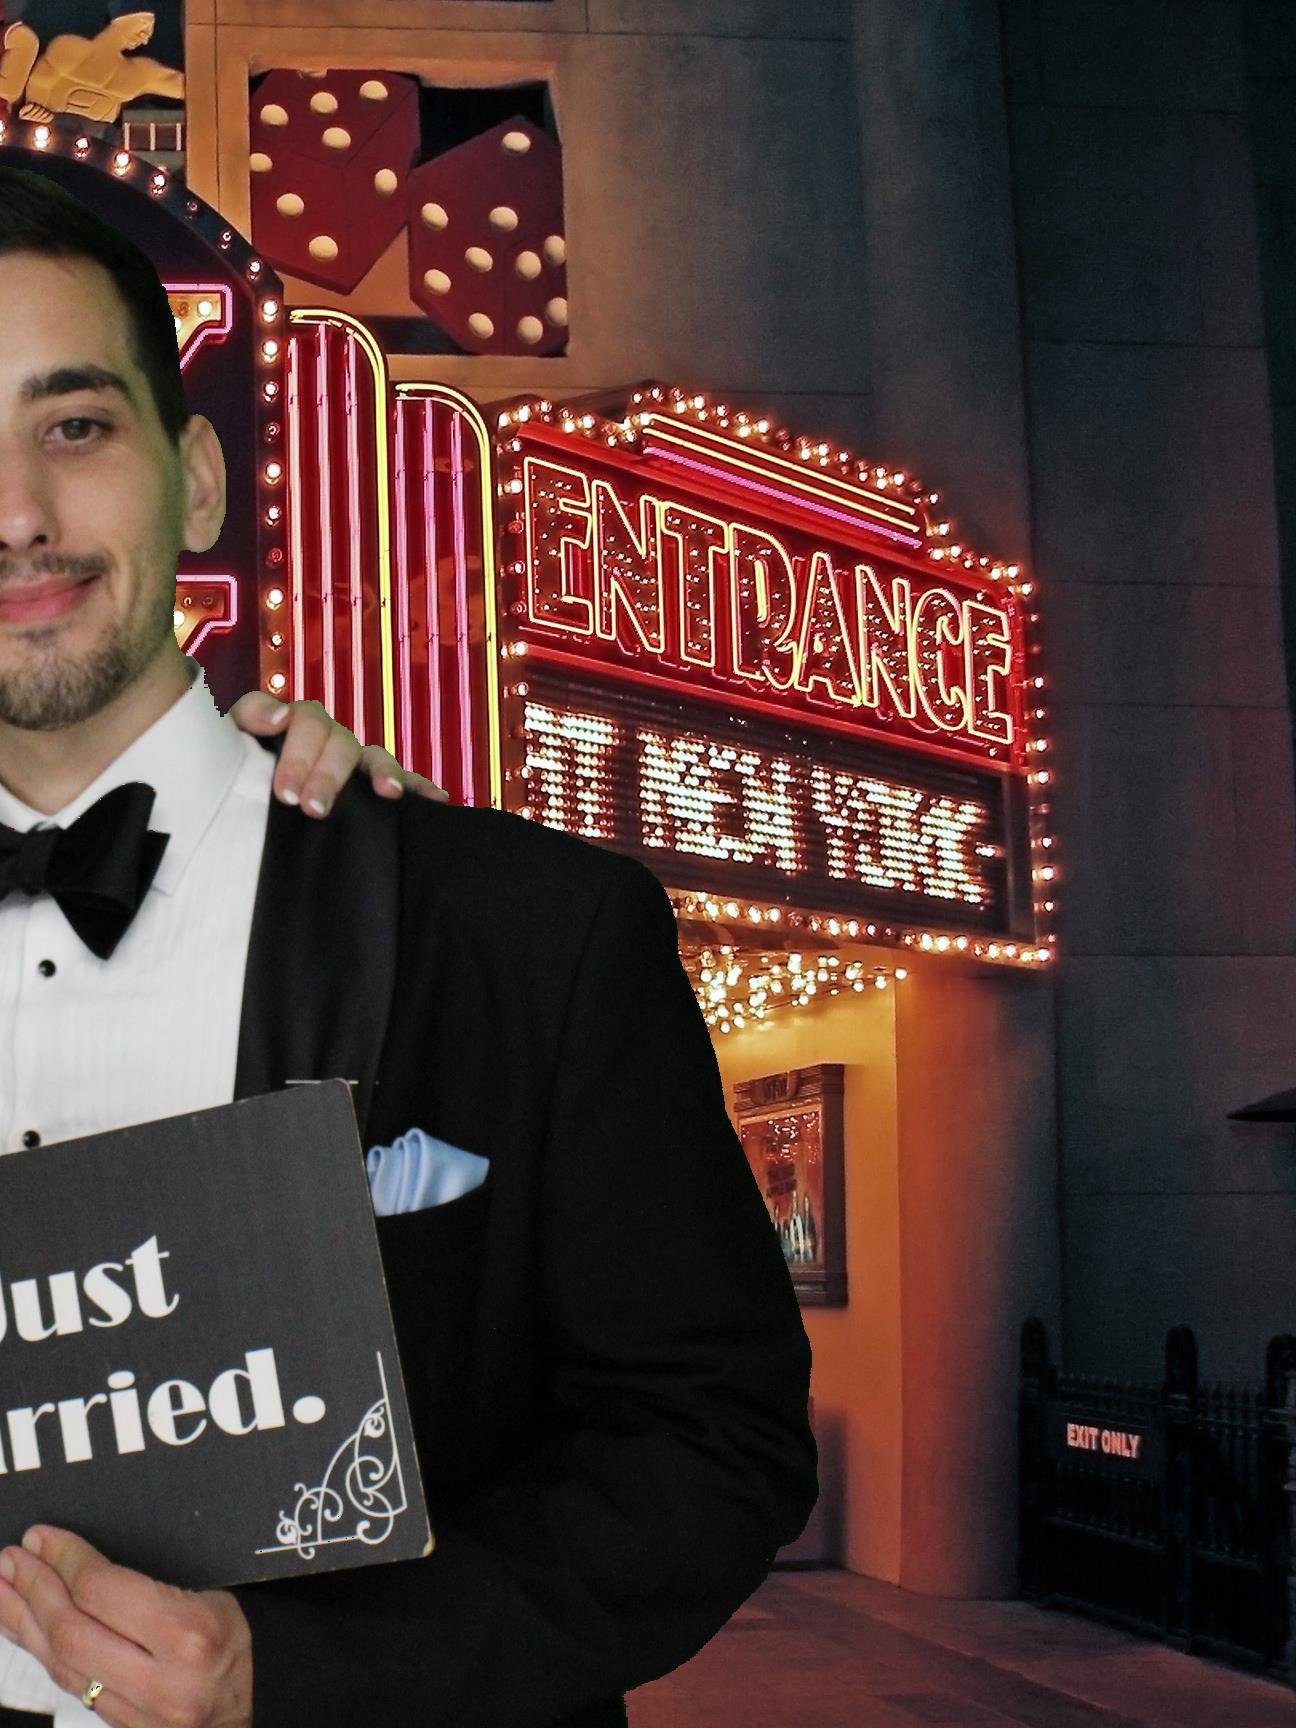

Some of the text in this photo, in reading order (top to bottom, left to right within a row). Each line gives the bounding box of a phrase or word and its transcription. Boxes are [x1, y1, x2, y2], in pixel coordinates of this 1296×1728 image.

[523, 456, 1014, 744] ENTRANCE
[1066, 1422, 1142, 1459] EXIT ONLY
